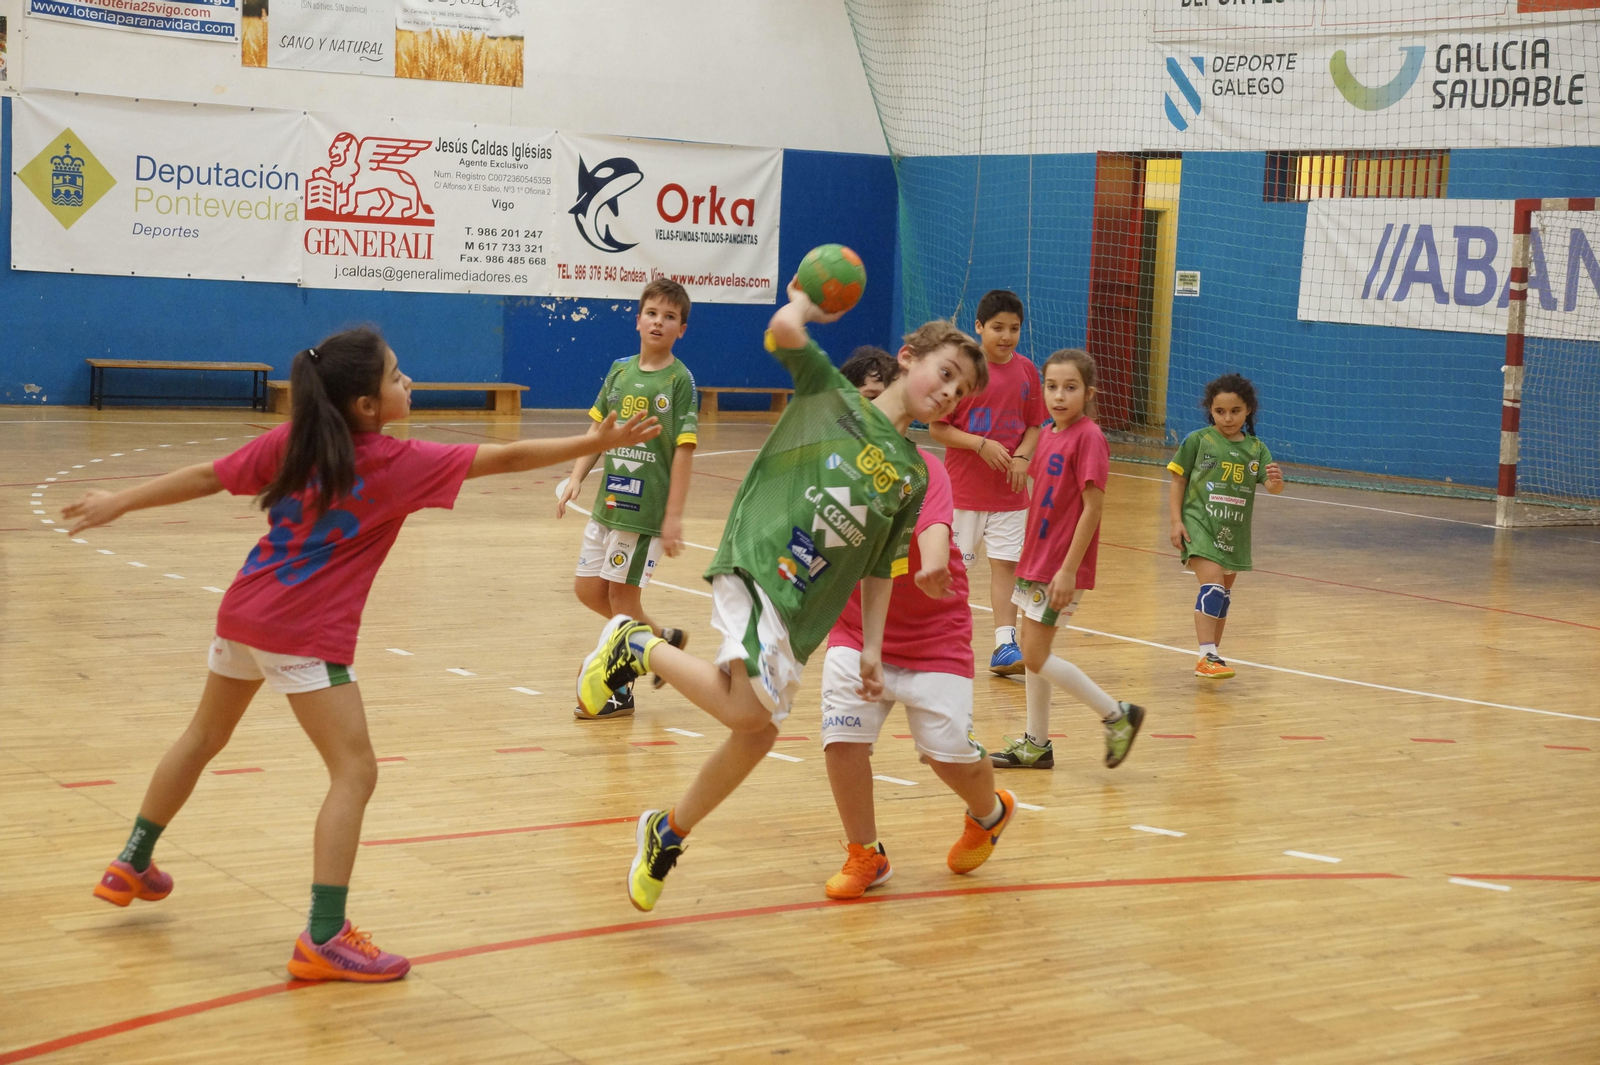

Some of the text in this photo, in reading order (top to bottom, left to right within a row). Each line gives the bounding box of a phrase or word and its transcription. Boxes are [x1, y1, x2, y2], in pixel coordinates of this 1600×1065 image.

[33, 1, 233, 35] www.loteriaparanavidad.com
[278, 34, 384, 57] SANO Y NATURAL
[1435, 38, 1550, 73] GALICIA
[1212, 53, 1298, 73] DEPORTE
[1211, 77, 1285, 96] GALEGO
[1432, 73, 1585, 109] SAUDABLE
[435, 137, 552, 161] Jesús Caldas Iglésias
[136, 155, 299, 191] Deputación
[459, 158, 529, 170] Agente Exclusivo
[433, 170, 454, 179] Num.
[455, 171, 486, 182] Registro
[434, 181, 442, 189] C/
[442, 182, 467, 191] Alfonso
[475, 183, 481, 191] El
[482, 184, 502, 194] Sabio,
[524, 187, 545, 196] Oficina
[546, 188, 552, 196] 2
[134, 187, 299, 221] Pontevedra
[491, 199, 515, 212] Vigo
[656, 183, 756, 227] Orka
[132, 222, 200, 239] Deportes
[465, 226, 543, 239] T. 986 201 247
[655, 228, 758, 246] VELAS-FUNDAS-TOLDOS-PANCARTAS
[303, 227, 435, 260] GENERALI
[464, 241, 544, 253] M 617 733 321
[460, 253, 547, 266] Fax. 986 485 668
[334, 265, 528, 284] j.caldas@generalimediadores.es
[557, 264, 573, 279] TEL.
[574, 265, 587, 280] 986
[589, 265, 602, 281] 376
[604, 266, 617, 281] 543
[670, 272, 770, 289] www.orkavelas.com
[617, 447, 657, 463] CESANTES
[1221, 461, 1245, 484] 75
[823, 504, 867, 547] CESANTES
